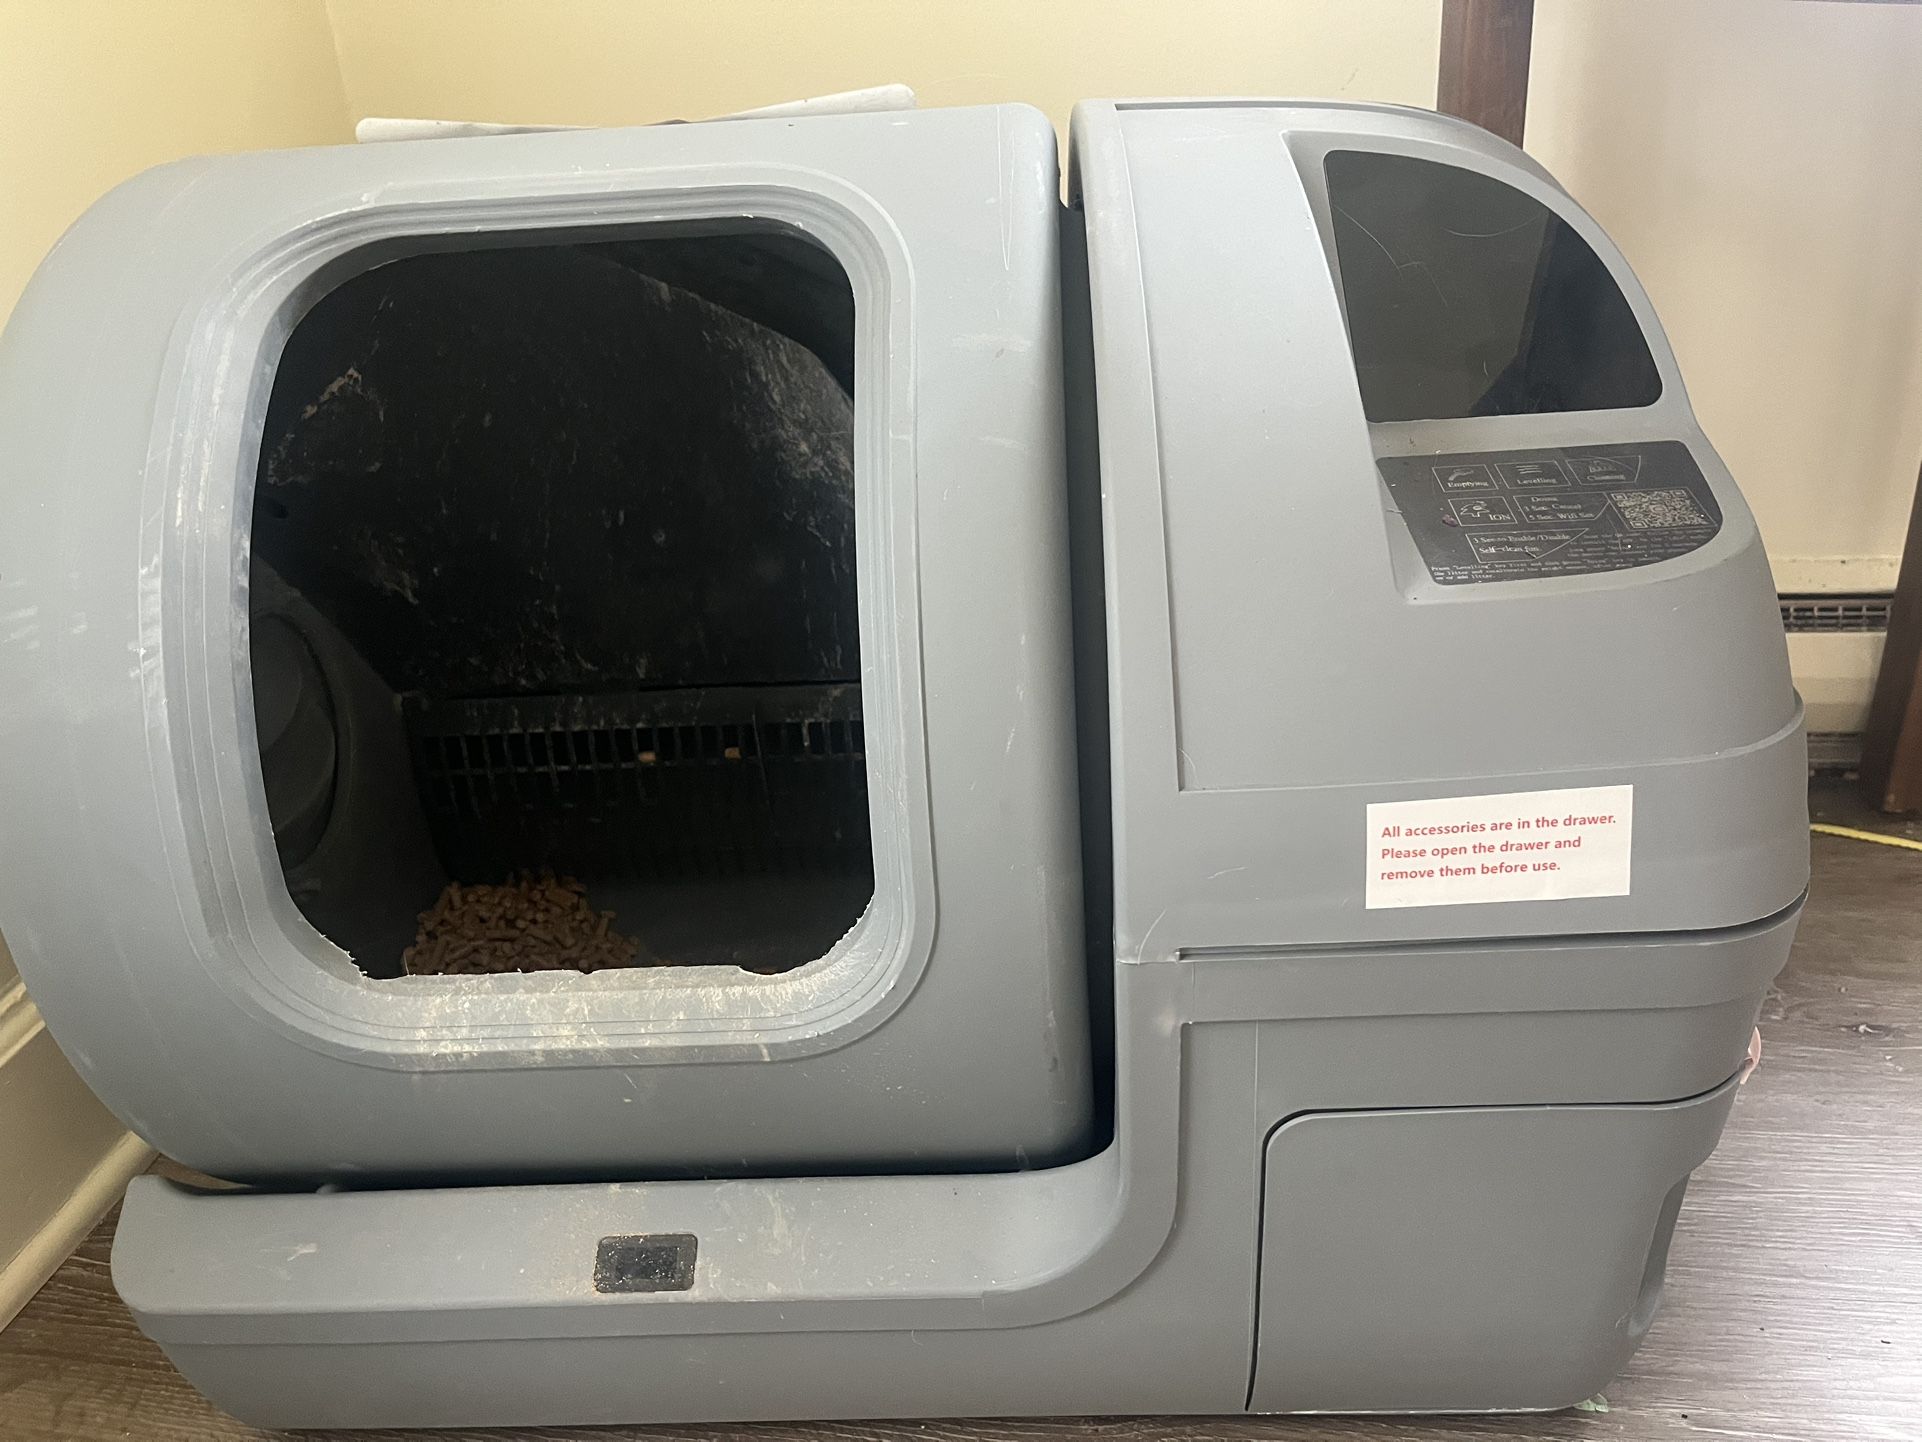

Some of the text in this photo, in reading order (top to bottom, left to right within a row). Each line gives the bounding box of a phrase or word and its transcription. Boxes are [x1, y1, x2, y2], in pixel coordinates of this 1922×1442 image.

[1488, 513, 1511, 521] ION
[1381, 814, 1617, 838] All accessories are in the drawer.
[1381, 836, 1582, 859] Please open the drawer and
[1381, 862, 1561, 880] remove them before use.
